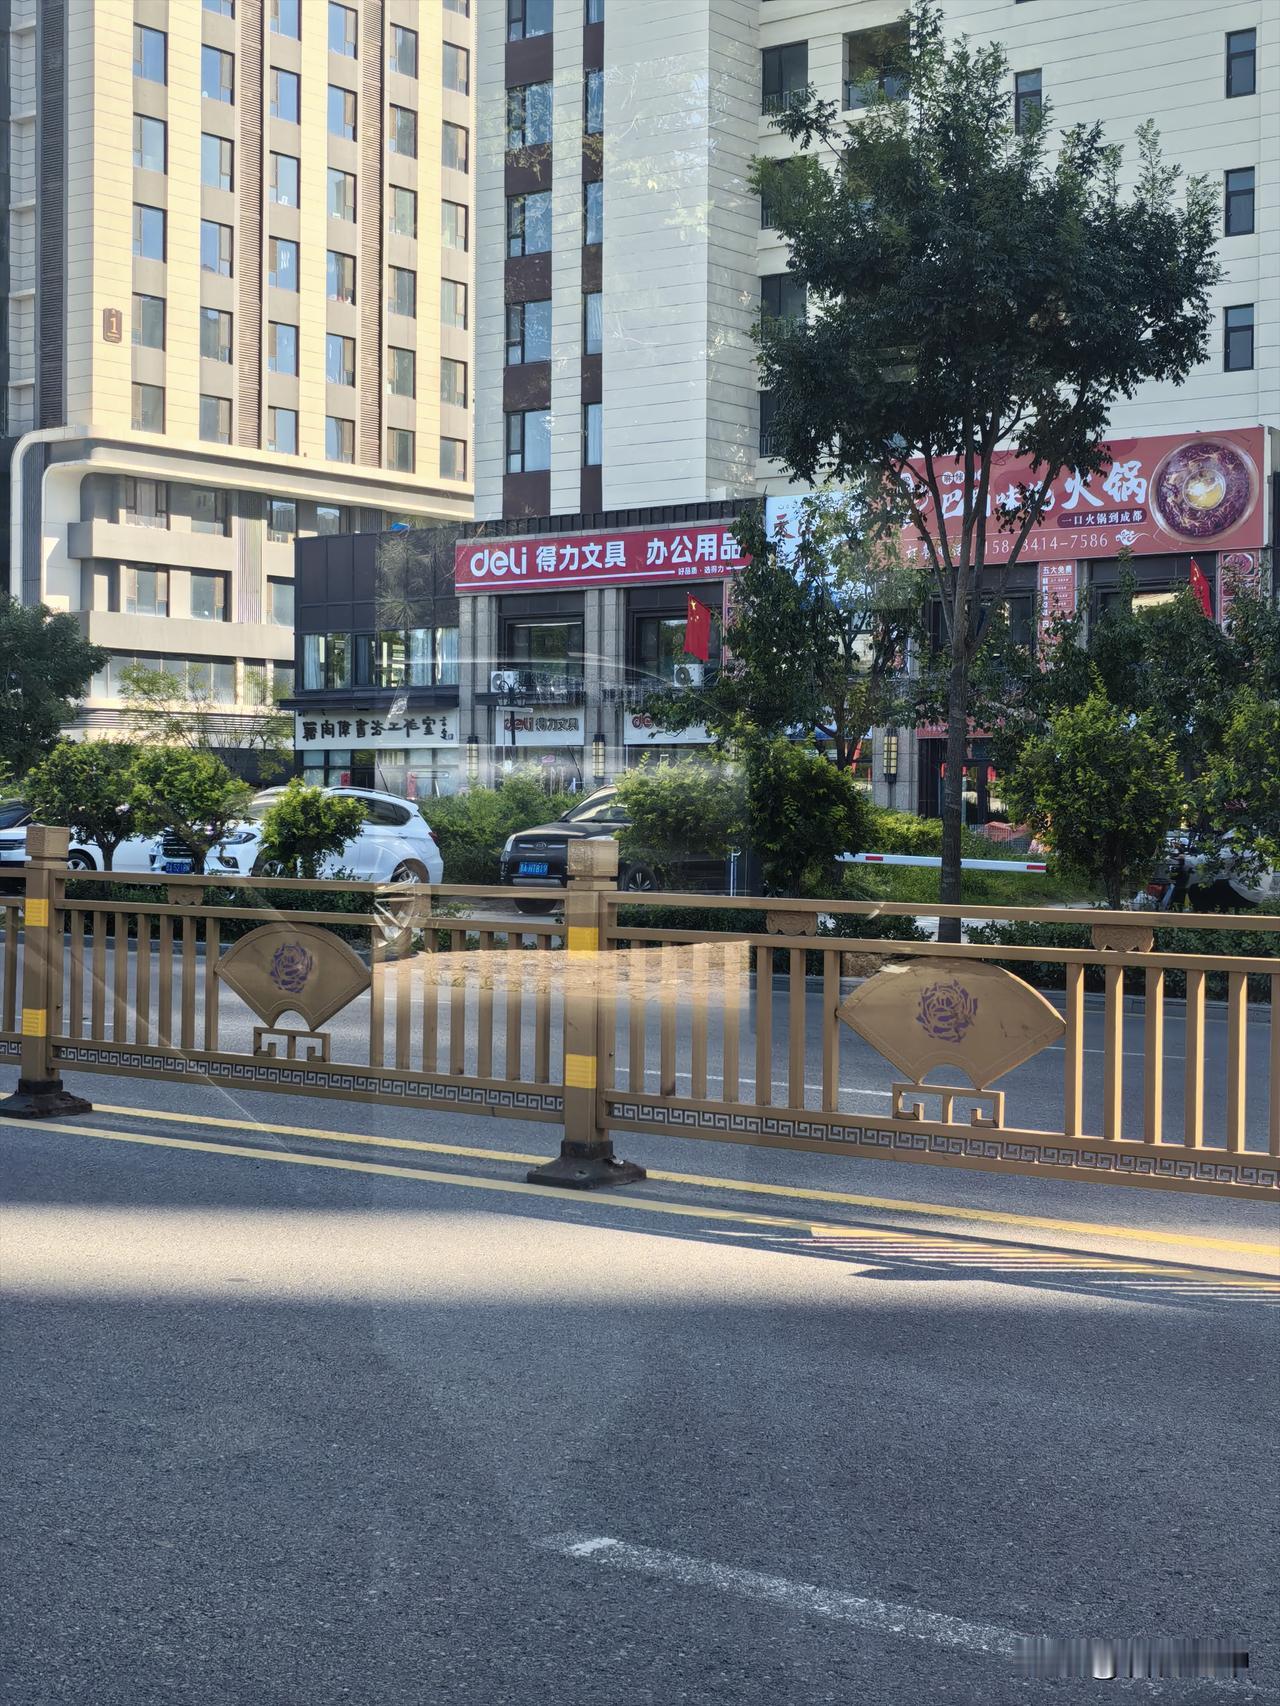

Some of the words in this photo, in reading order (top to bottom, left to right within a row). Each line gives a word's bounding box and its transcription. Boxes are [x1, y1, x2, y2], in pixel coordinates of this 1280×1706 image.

[109, 317, 118, 334] 1
[1061, 509, 1143, 526] 一口火锅到成都
[470, 546, 528, 577] deli
[536, 540, 626, 573] 得力文具
[646, 533, 742, 565] 办公用品
[504, 717, 534, 732] deli
[535, 717, 580, 732] 得力文具
